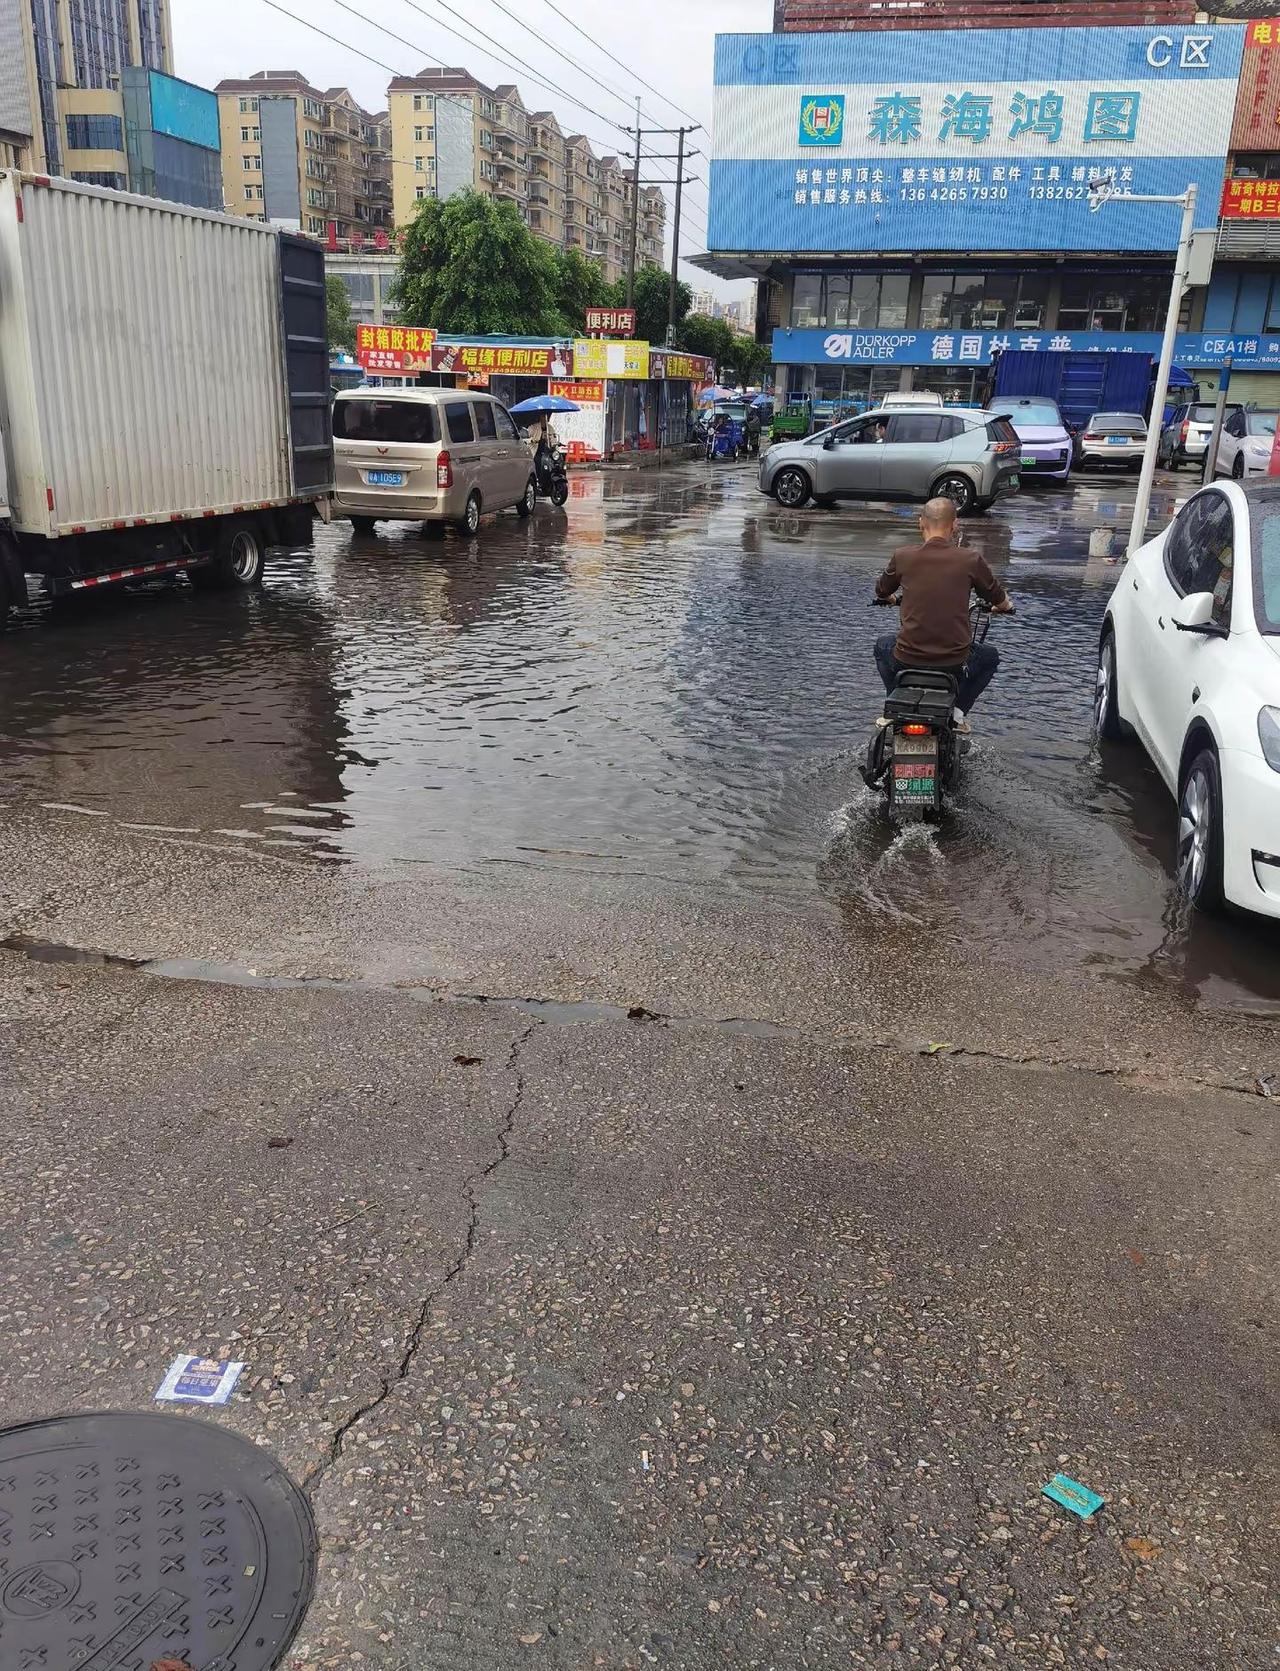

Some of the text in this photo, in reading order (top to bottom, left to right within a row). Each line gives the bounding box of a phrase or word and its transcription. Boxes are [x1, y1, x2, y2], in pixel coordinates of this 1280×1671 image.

[1146, 35, 1213, 67] C区
[866, 90, 1140, 144] 森海鸿图
[902, 167, 981, 183] 整车缝纫机
[992, 166, 1022, 181] 配件
[1032, 167, 1061, 181] 工具
[1071, 166, 1133, 181] 辅料批发
[1227, 199, 1280, 214] 一期B三
[587, 312, 632, 330] 便利店
[361, 328, 434, 352] 封箱胶批发
[1204, 339, 1257, 354] C区A1档
[461, 347, 548, 368] 福缘便利店
[853, 347, 894, 359] ADLER
